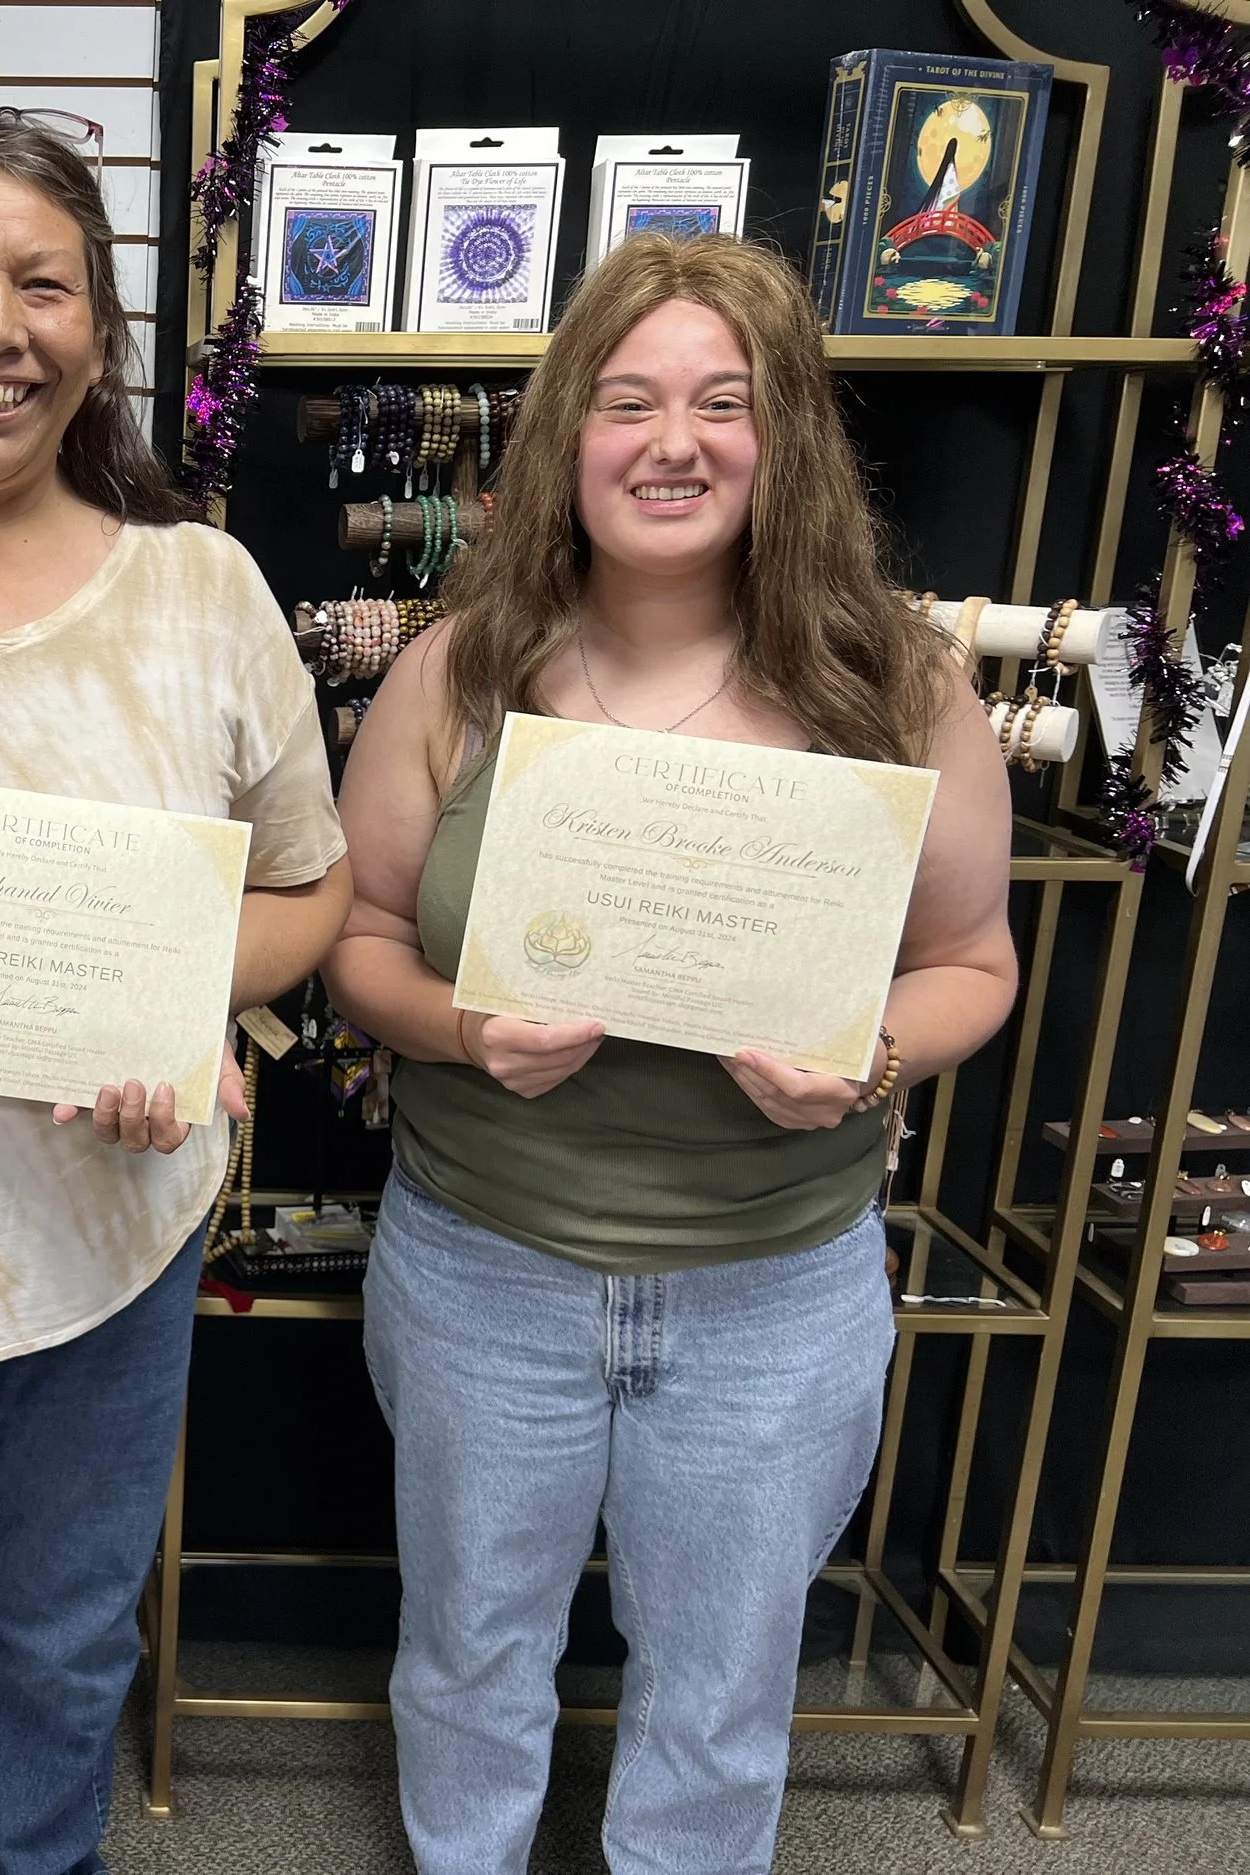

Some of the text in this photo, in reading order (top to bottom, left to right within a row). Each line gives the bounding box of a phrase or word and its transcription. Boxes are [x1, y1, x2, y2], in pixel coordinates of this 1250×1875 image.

[926, 66, 950, 74] TAROT
[964, 69, 978, 77] THE
[979, 71, 1005, 79] DIVINE
[309, 171, 323, 179] Table
[342, 172, 357, 180] 100%
[472, 178, 483, 186] Dye
[506, 178, 514, 186] of
[653, 168, 668, 176] Table
[670, 168, 685, 176] Cloth
[864, 176, 874, 204] PIECES
[612, 753, 809, 801] CERTIFICATE
[665, 782, 749, 803] OF COMPLETION
[14, 835, 91, 855] OF COMPLETION
[541, 800, 866, 878] Kristen Brooke Anderson
[5, 851, 29, 861] Hereby
[30, 855, 55, 864] Declare
[69, 861, 91, 870] Certify
[92, 864, 107, 872] That
[538, 851, 553, 859] has
[554, 854, 601, 868] successfully
[603, 862, 644, 875] completed
[659, 871, 690, 883] training
[690, 877, 743, 892] requirements
[745, 886, 761, 894] and
[762, 889, 808, 902] attunement
[809, 896, 821, 904] for
[63, 878, 136, 915] Vivier
[599, 874, 626, 884] Master
[628, 879, 649, 888] Level
[650, 882, 666, 890] and
[676, 887, 707, 898] granted
[708, 892, 755, 906] certification
[586, 889, 778, 935] USUI REIKI MASTER
[13, 922, 41, 933] training
[42, 927, 90, 940] requirements
[108, 937, 149, 949] attunement
[150, 943, 160, 951] for
[162, 945, 181, 954] Reiki
[619, 916, 656, 928] Presented
[669, 925, 696, 936] August
[717, 933, 737, 942] 2024
[30, 937, 58, 948] granted
[59, 942, 101, 954] certification
[49, 959, 124, 983] MASTER
[633, 966, 701, 983] SAMANTHA BEPPU
[25, 975, 49, 986] August
[69, 982, 86, 991] 2024
[34, 1025, 57, 1034] BEPPU
